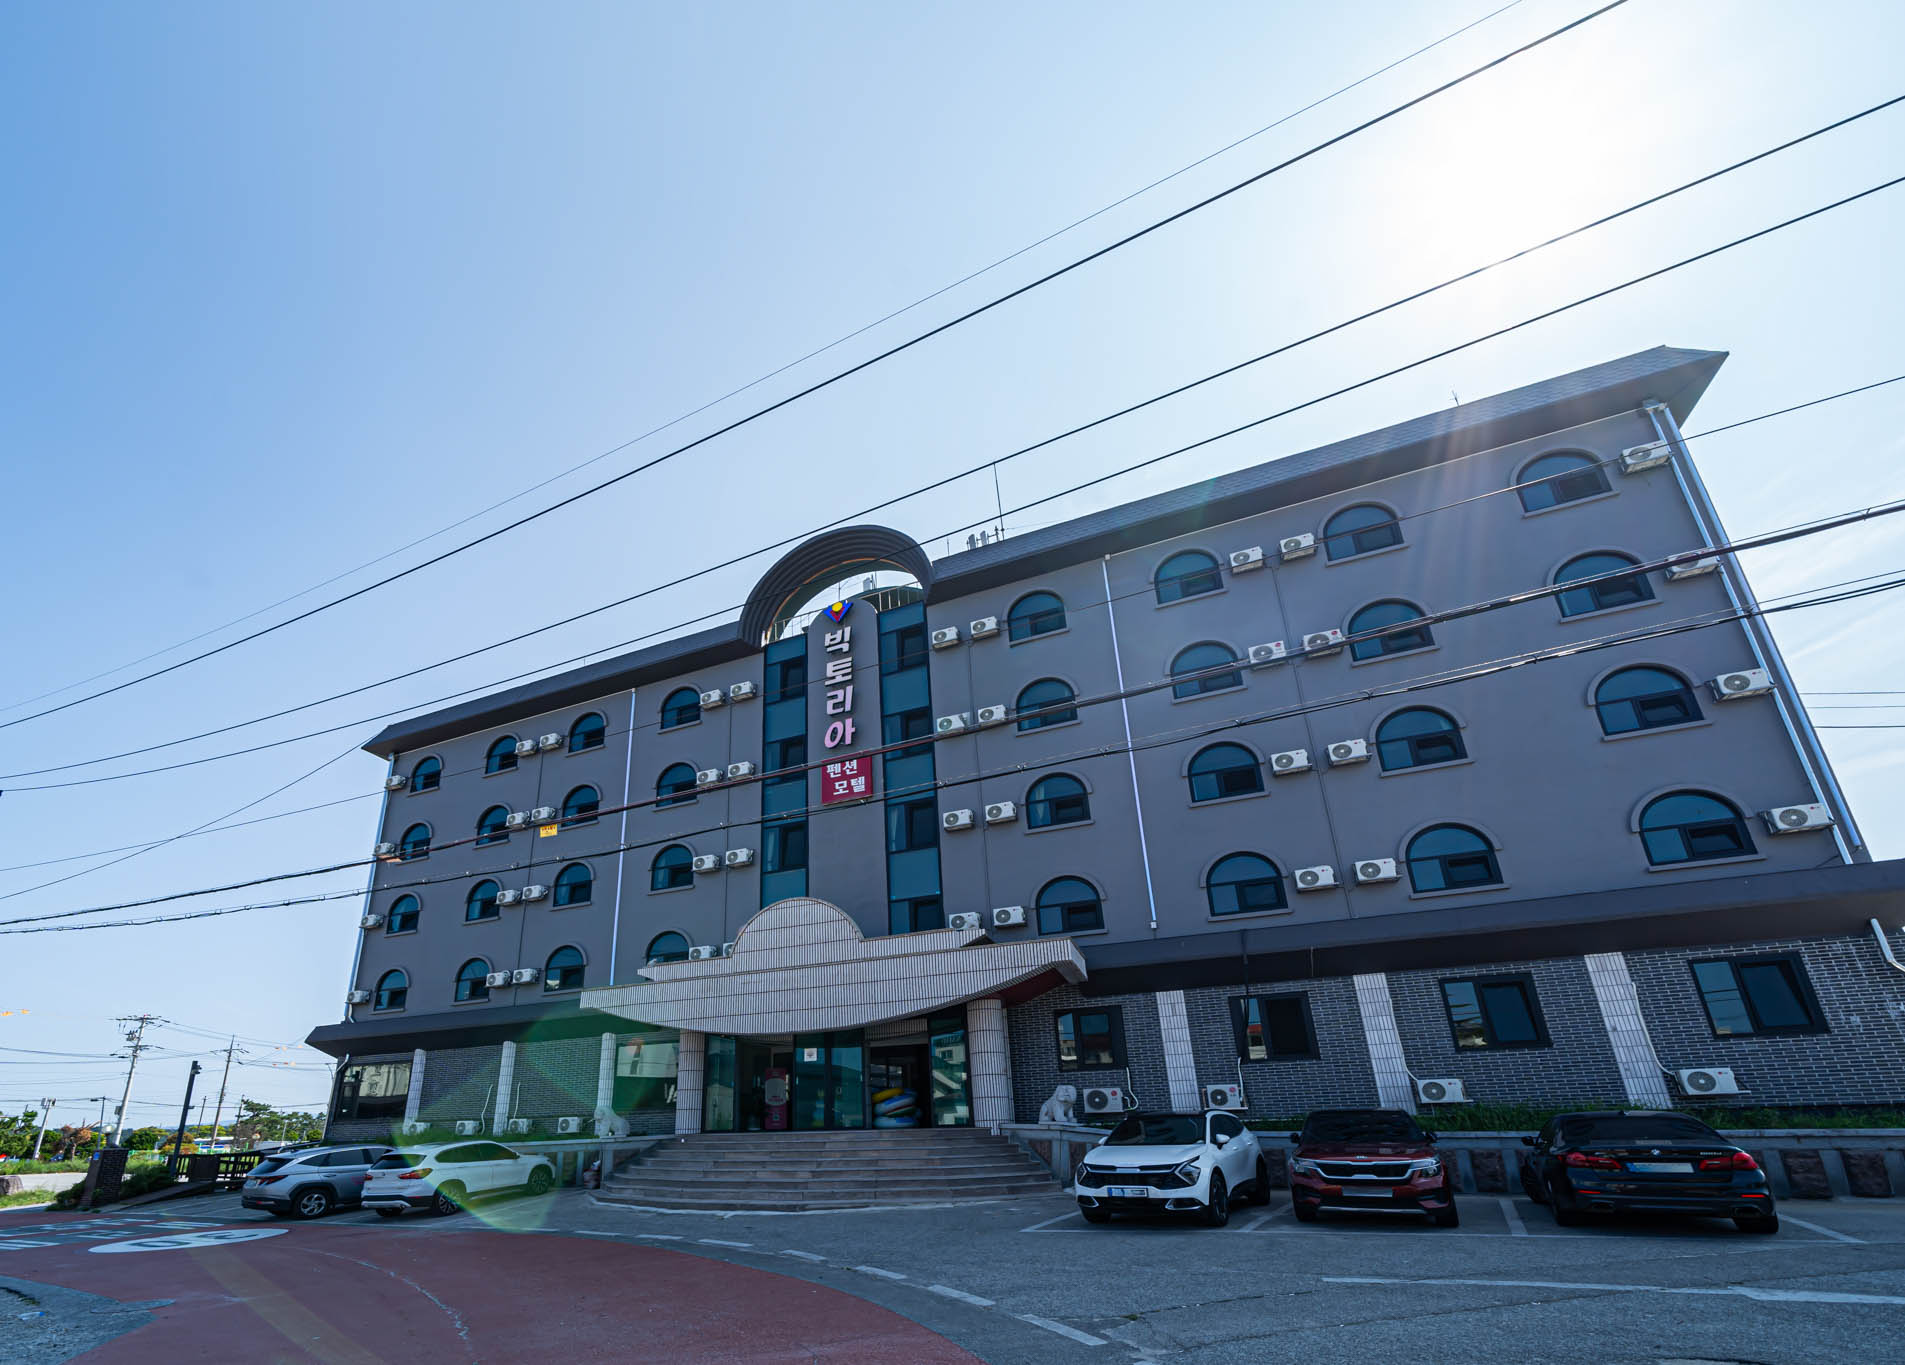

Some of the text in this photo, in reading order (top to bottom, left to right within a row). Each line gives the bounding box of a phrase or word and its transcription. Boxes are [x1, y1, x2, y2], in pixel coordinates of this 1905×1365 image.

[824, 626, 856, 749] 빅토리아
[826, 759, 857, 778] 펜션
[833, 776, 866, 796] 모텔
